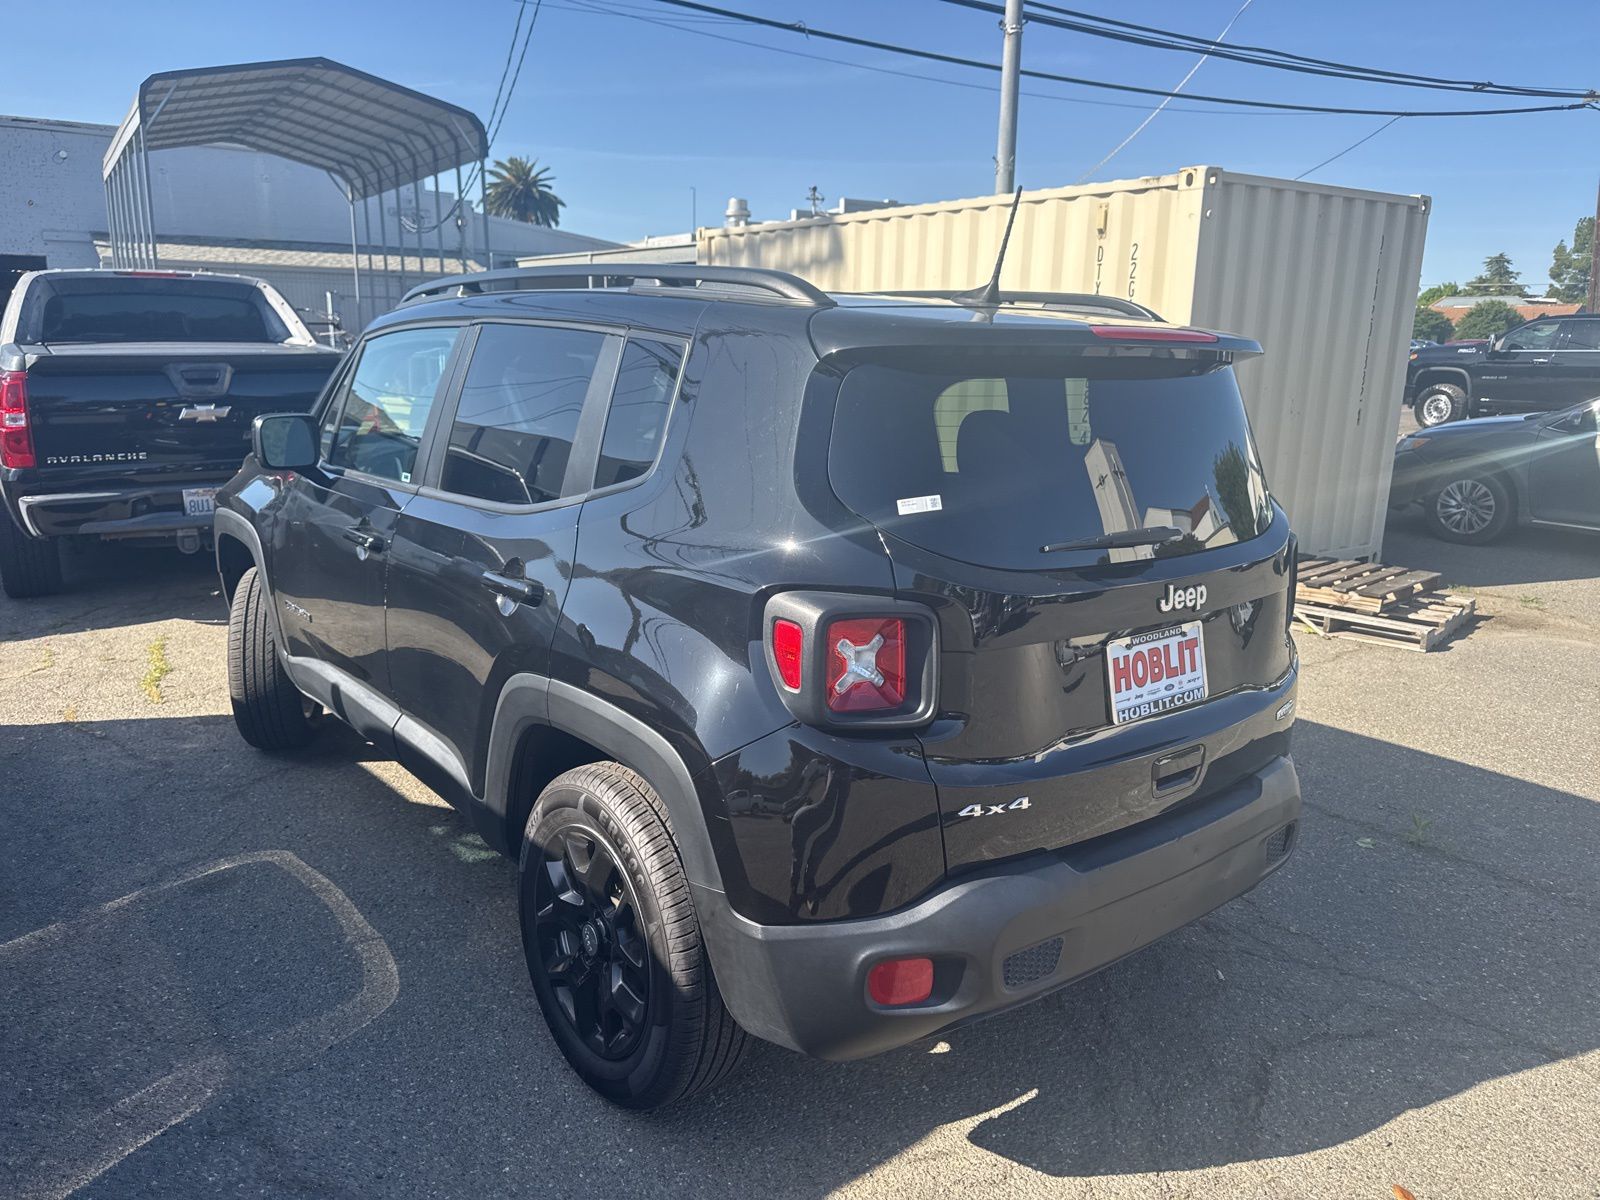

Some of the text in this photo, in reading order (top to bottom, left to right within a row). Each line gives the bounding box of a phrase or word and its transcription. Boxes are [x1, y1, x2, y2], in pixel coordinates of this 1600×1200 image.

[1128, 243, 1139, 301] 22G
[47, 452, 147, 464] AVALANCHE
[1159, 584, 1207, 612] Jeep
[1132, 627, 1182, 645] WOODLAND
[1112, 637, 1198, 693] HOBLIT
[1118, 687, 1205, 722] HOBLIT.COM
[958, 796, 1032, 817] 4x4
